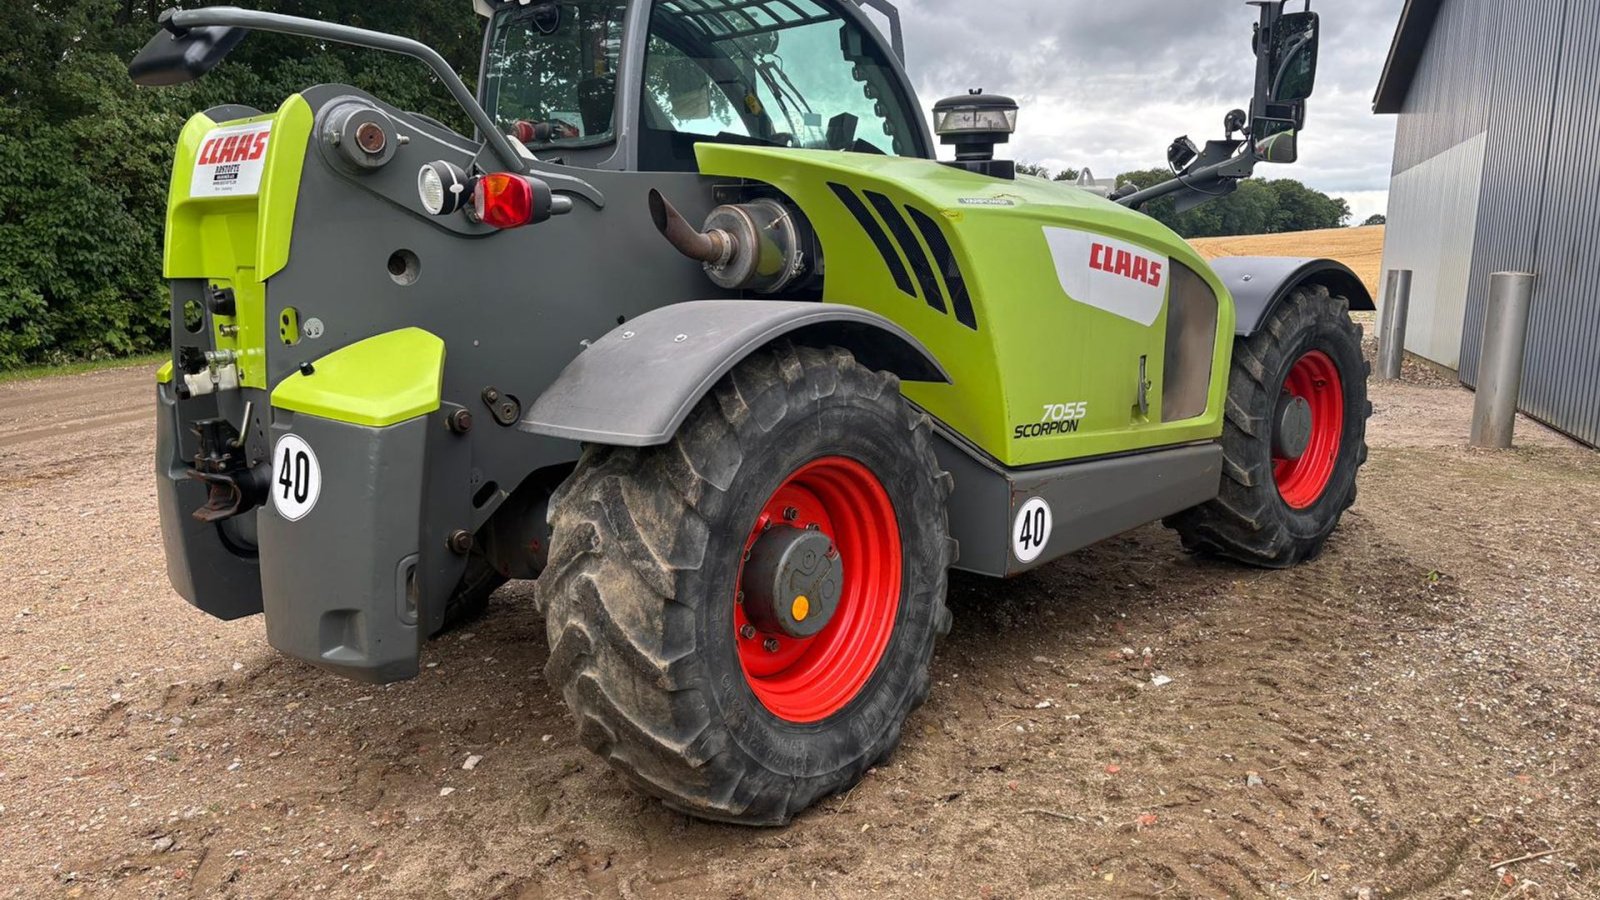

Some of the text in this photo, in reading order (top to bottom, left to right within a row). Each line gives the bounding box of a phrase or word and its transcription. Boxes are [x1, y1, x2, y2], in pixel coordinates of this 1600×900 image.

[198, 131, 271, 165] CLAAS
[1089, 242, 1162, 288] CLAAS
[1013, 419, 1079, 439] SCORPION
[1041, 401, 1088, 422] 7055
[279, 447, 310, 504] 40
[1019, 506, 1045, 550] 40
